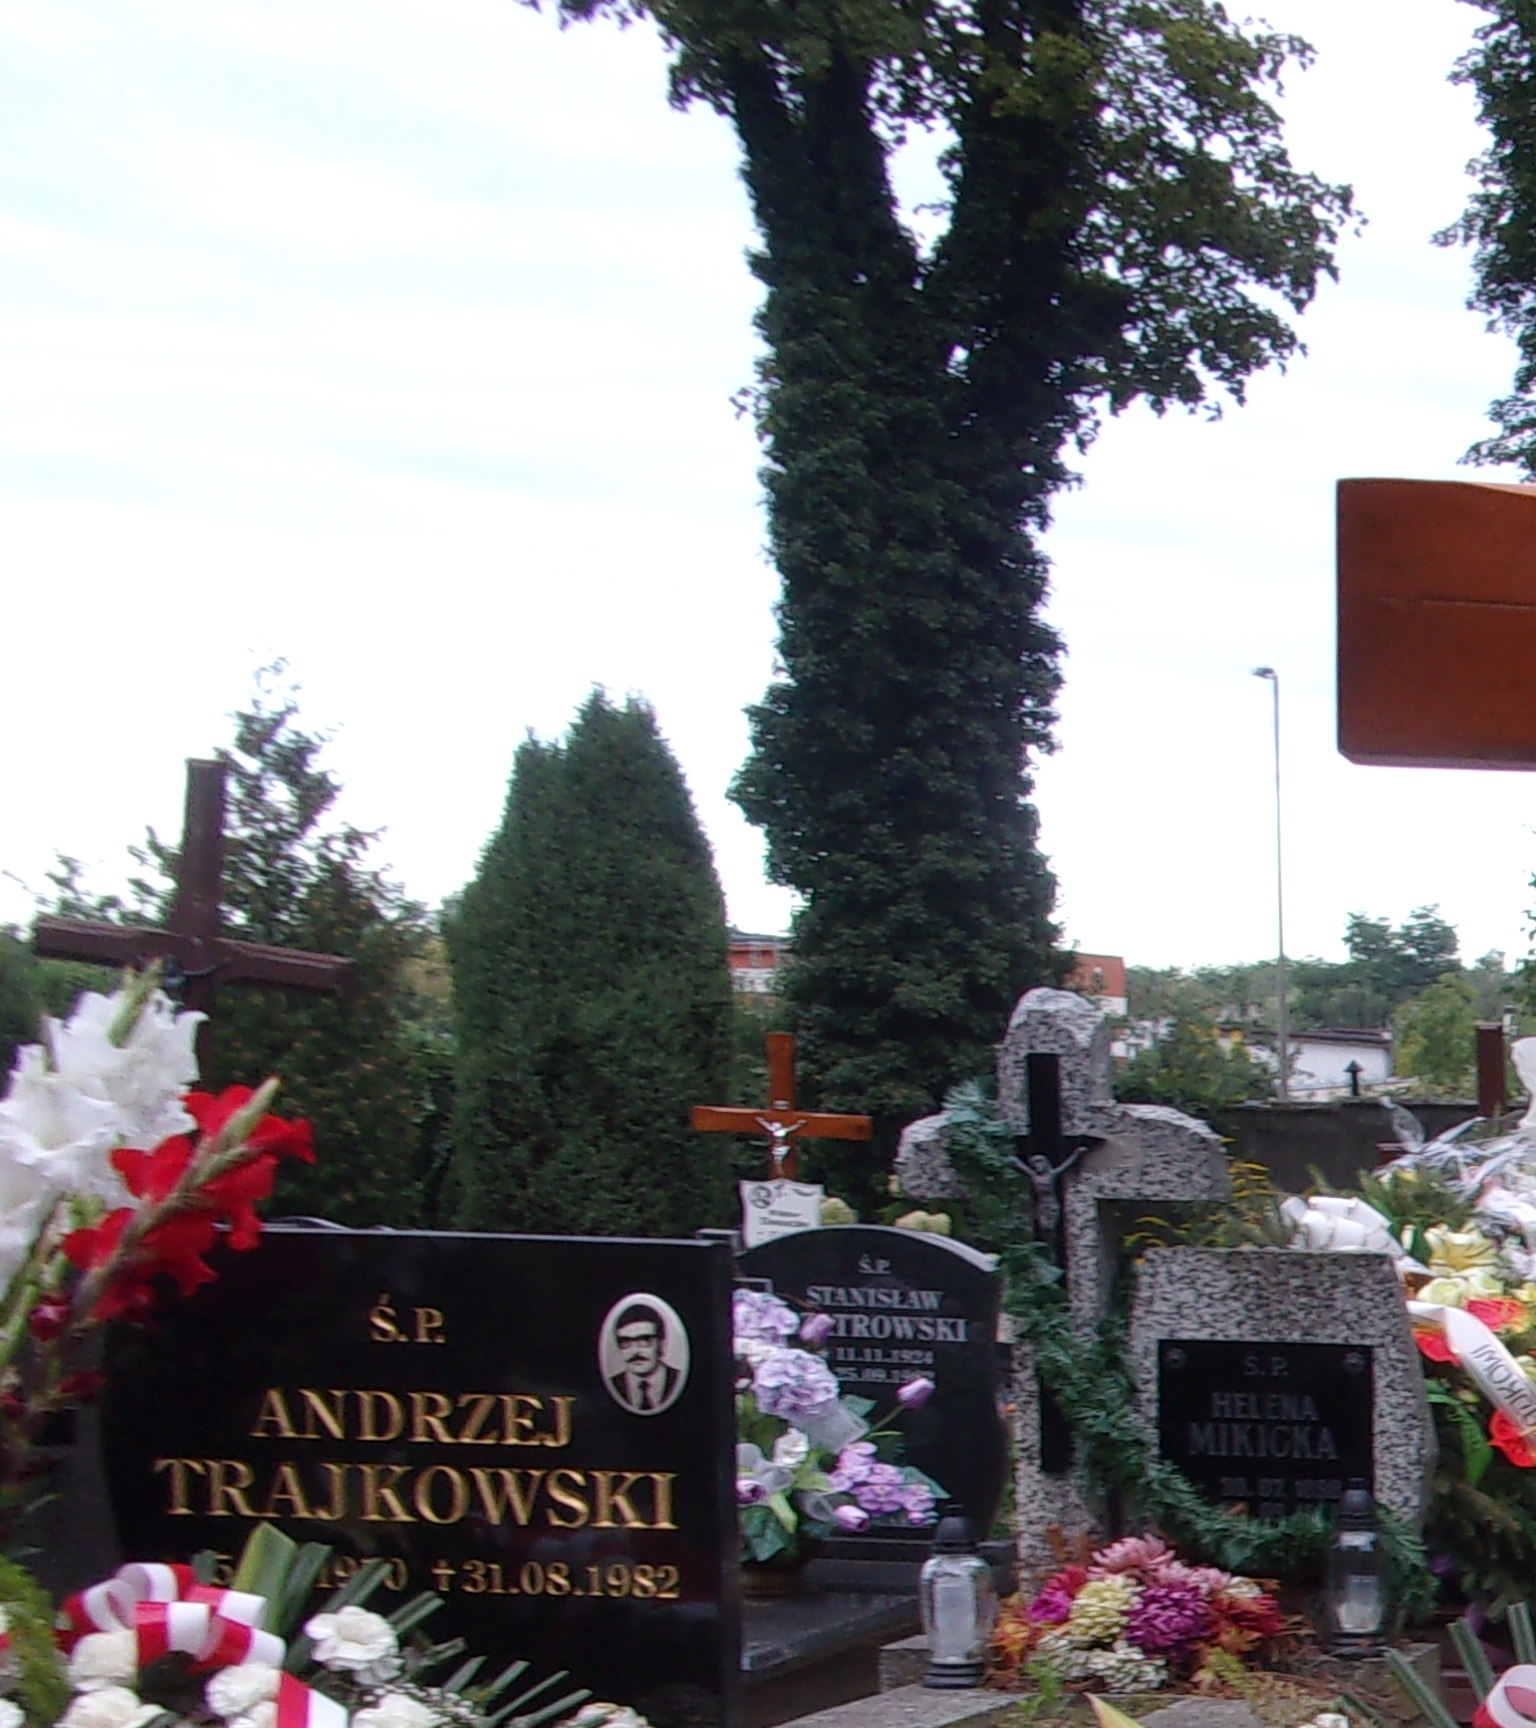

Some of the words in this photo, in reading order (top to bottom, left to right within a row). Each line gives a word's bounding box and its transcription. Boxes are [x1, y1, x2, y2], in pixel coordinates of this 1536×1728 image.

[806, 1285, 943, 1311] STANISŁAW
[248, 1386, 578, 1448] ANDRZEJ
[1210, 1391, 1319, 1421] HELENA
[1188, 1421, 1339, 1460] MIKICKA
[154, 1458, 679, 1531] TRAJKOWSKI
[462, 1557, 680, 1599] 31.08.1982
